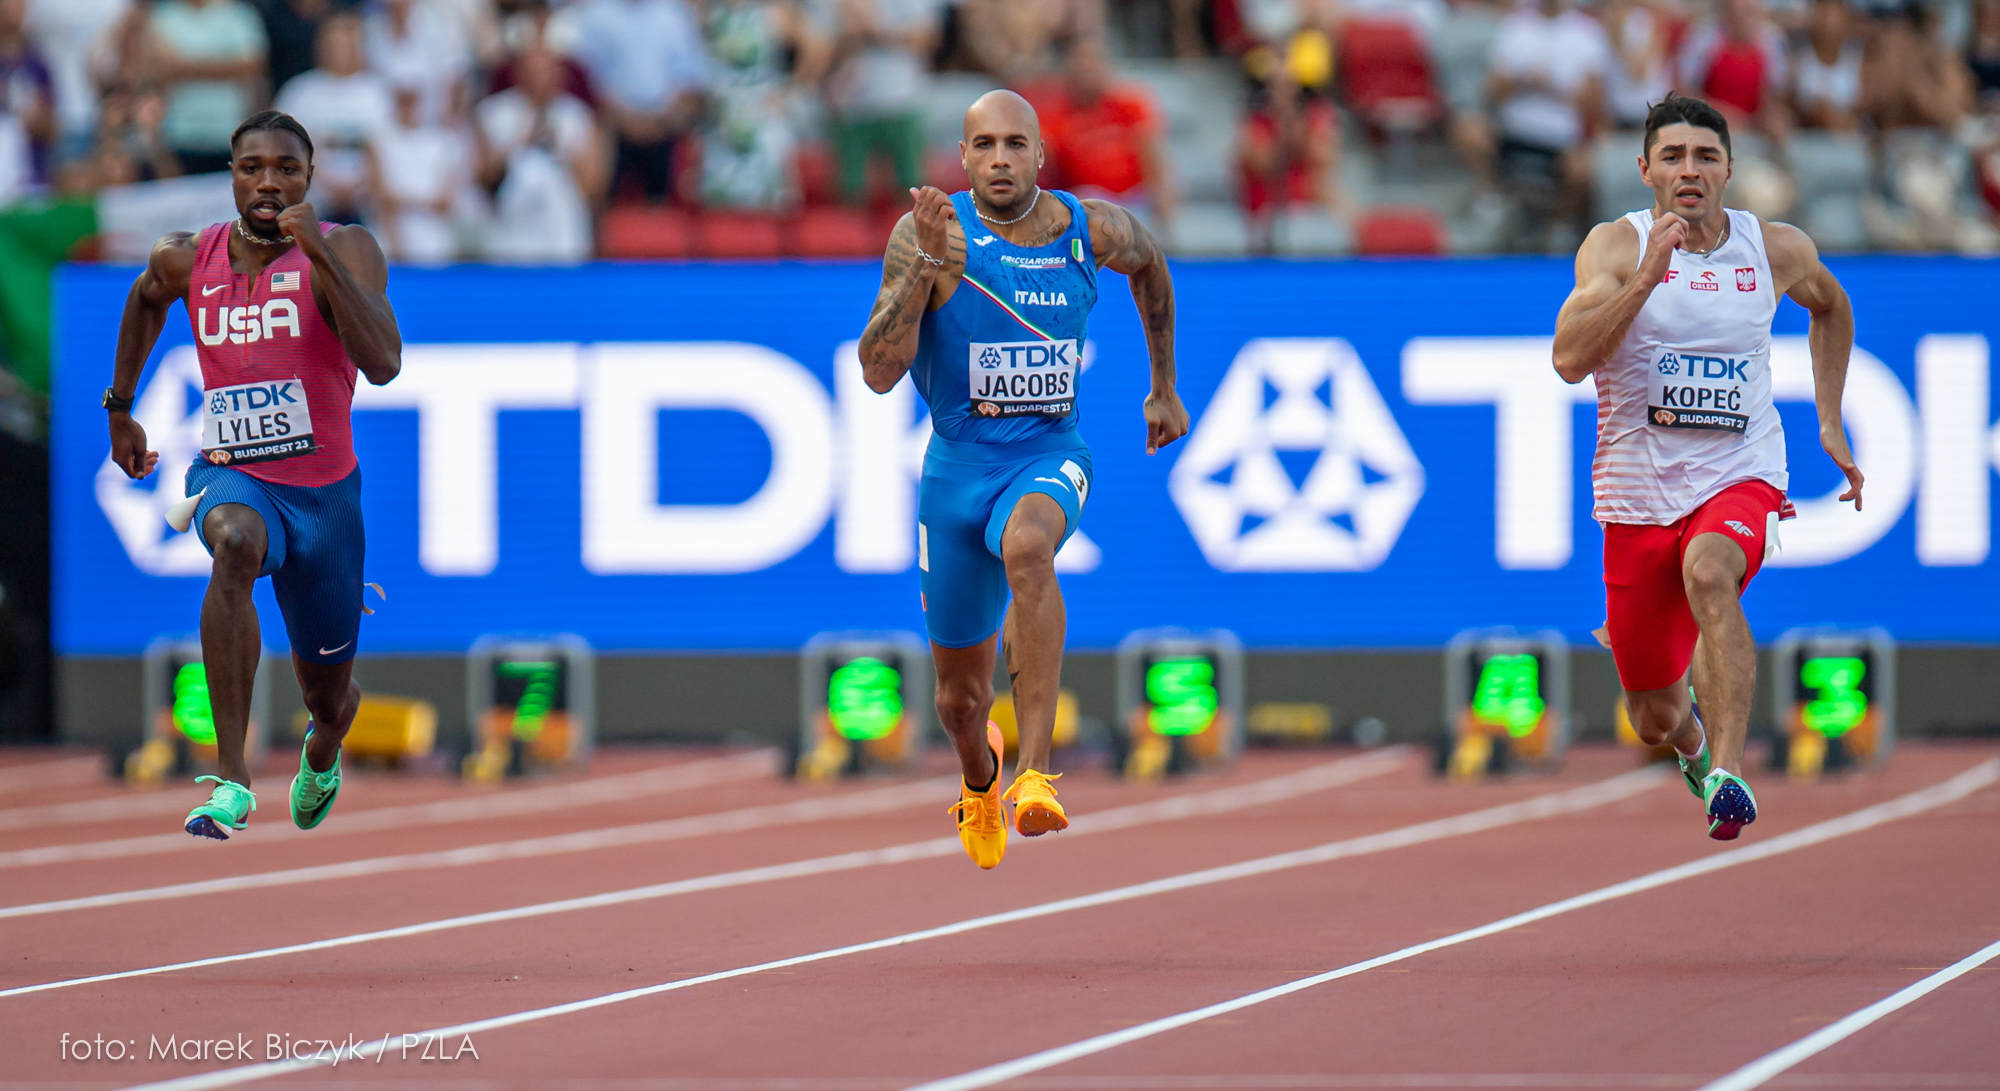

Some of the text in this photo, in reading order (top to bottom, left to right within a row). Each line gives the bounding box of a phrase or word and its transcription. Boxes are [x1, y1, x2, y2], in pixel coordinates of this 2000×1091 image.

[1014, 290, 1068, 306] ITALIA
[1691, 282, 1717, 290] ORLEN
[198, 299, 300, 345] USA
[1001, 343, 1070, 368] TDK
[1680, 354, 1750, 382] TDK
[226, 383, 297, 411] TDK
[977, 371, 1069, 398] JACOBS
[1003, 402, 1071, 414] BUDAPEST 23
[1662, 385, 1741, 412] KOPEĆ
[217, 412, 291, 444] LYLES
[1679, 414, 1736, 427] BUDAPEST
[234, 439, 309, 459] BUDAPEST 23
[1073, 471, 1085, 493] 3
[1724, 520, 1755, 537] 4F
[495, 660, 565, 742] 7
[1146, 656, 1218, 736] 5
[1472, 653, 1544, 738] 4
[1801, 656, 1868, 738] 3
